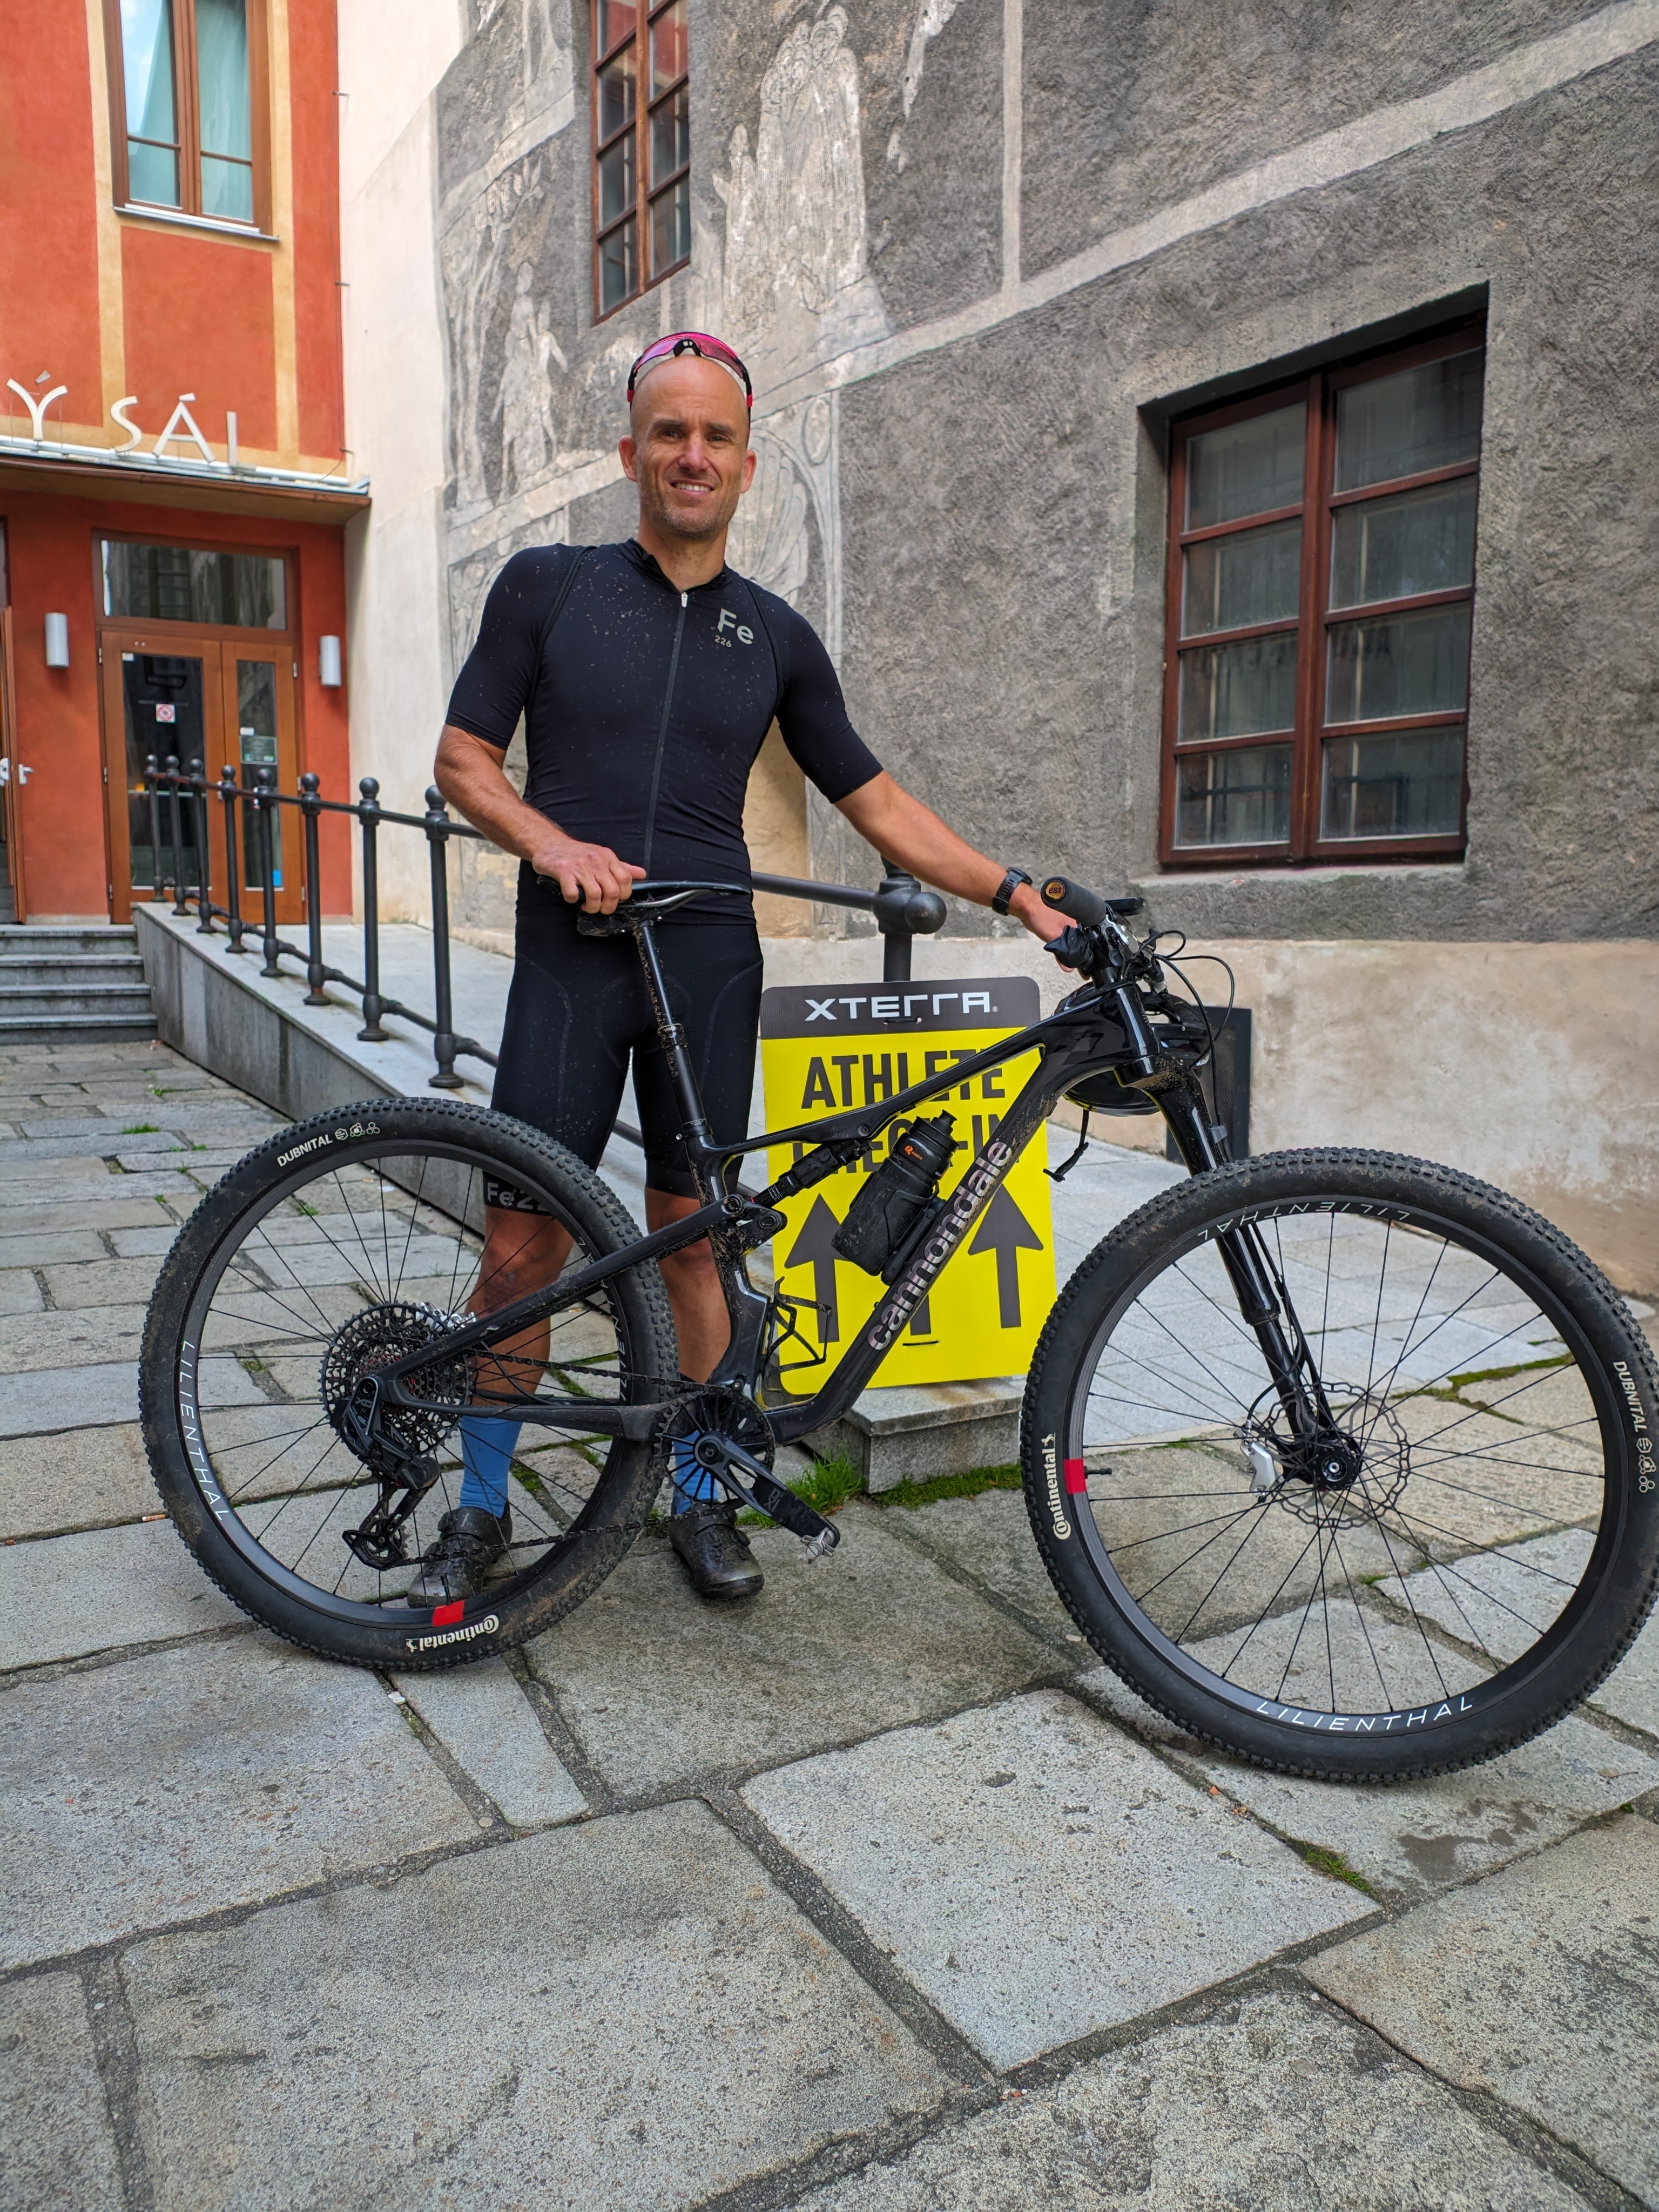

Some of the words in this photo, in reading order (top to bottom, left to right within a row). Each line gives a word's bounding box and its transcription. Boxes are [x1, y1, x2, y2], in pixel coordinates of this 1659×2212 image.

[109, 392, 257, 472] SÁL
[714, 635, 732, 648] 226
[717, 608, 754, 644] Fe
[277, 1134, 333, 1167] DUBNITAL
[1197, 1202, 1411, 1241] LILIENTHAL
[868, 1142, 1011, 1350] cannondale
[1613, 1360, 1648, 1433] DUBNITAL
[179, 1340, 230, 1521] LILIENTHAL
[1042, 1448, 1072, 1540] Continental
[419, 1614, 500, 1652] Continental
[1256, 1696, 1473, 1731] LILIENTHAL
